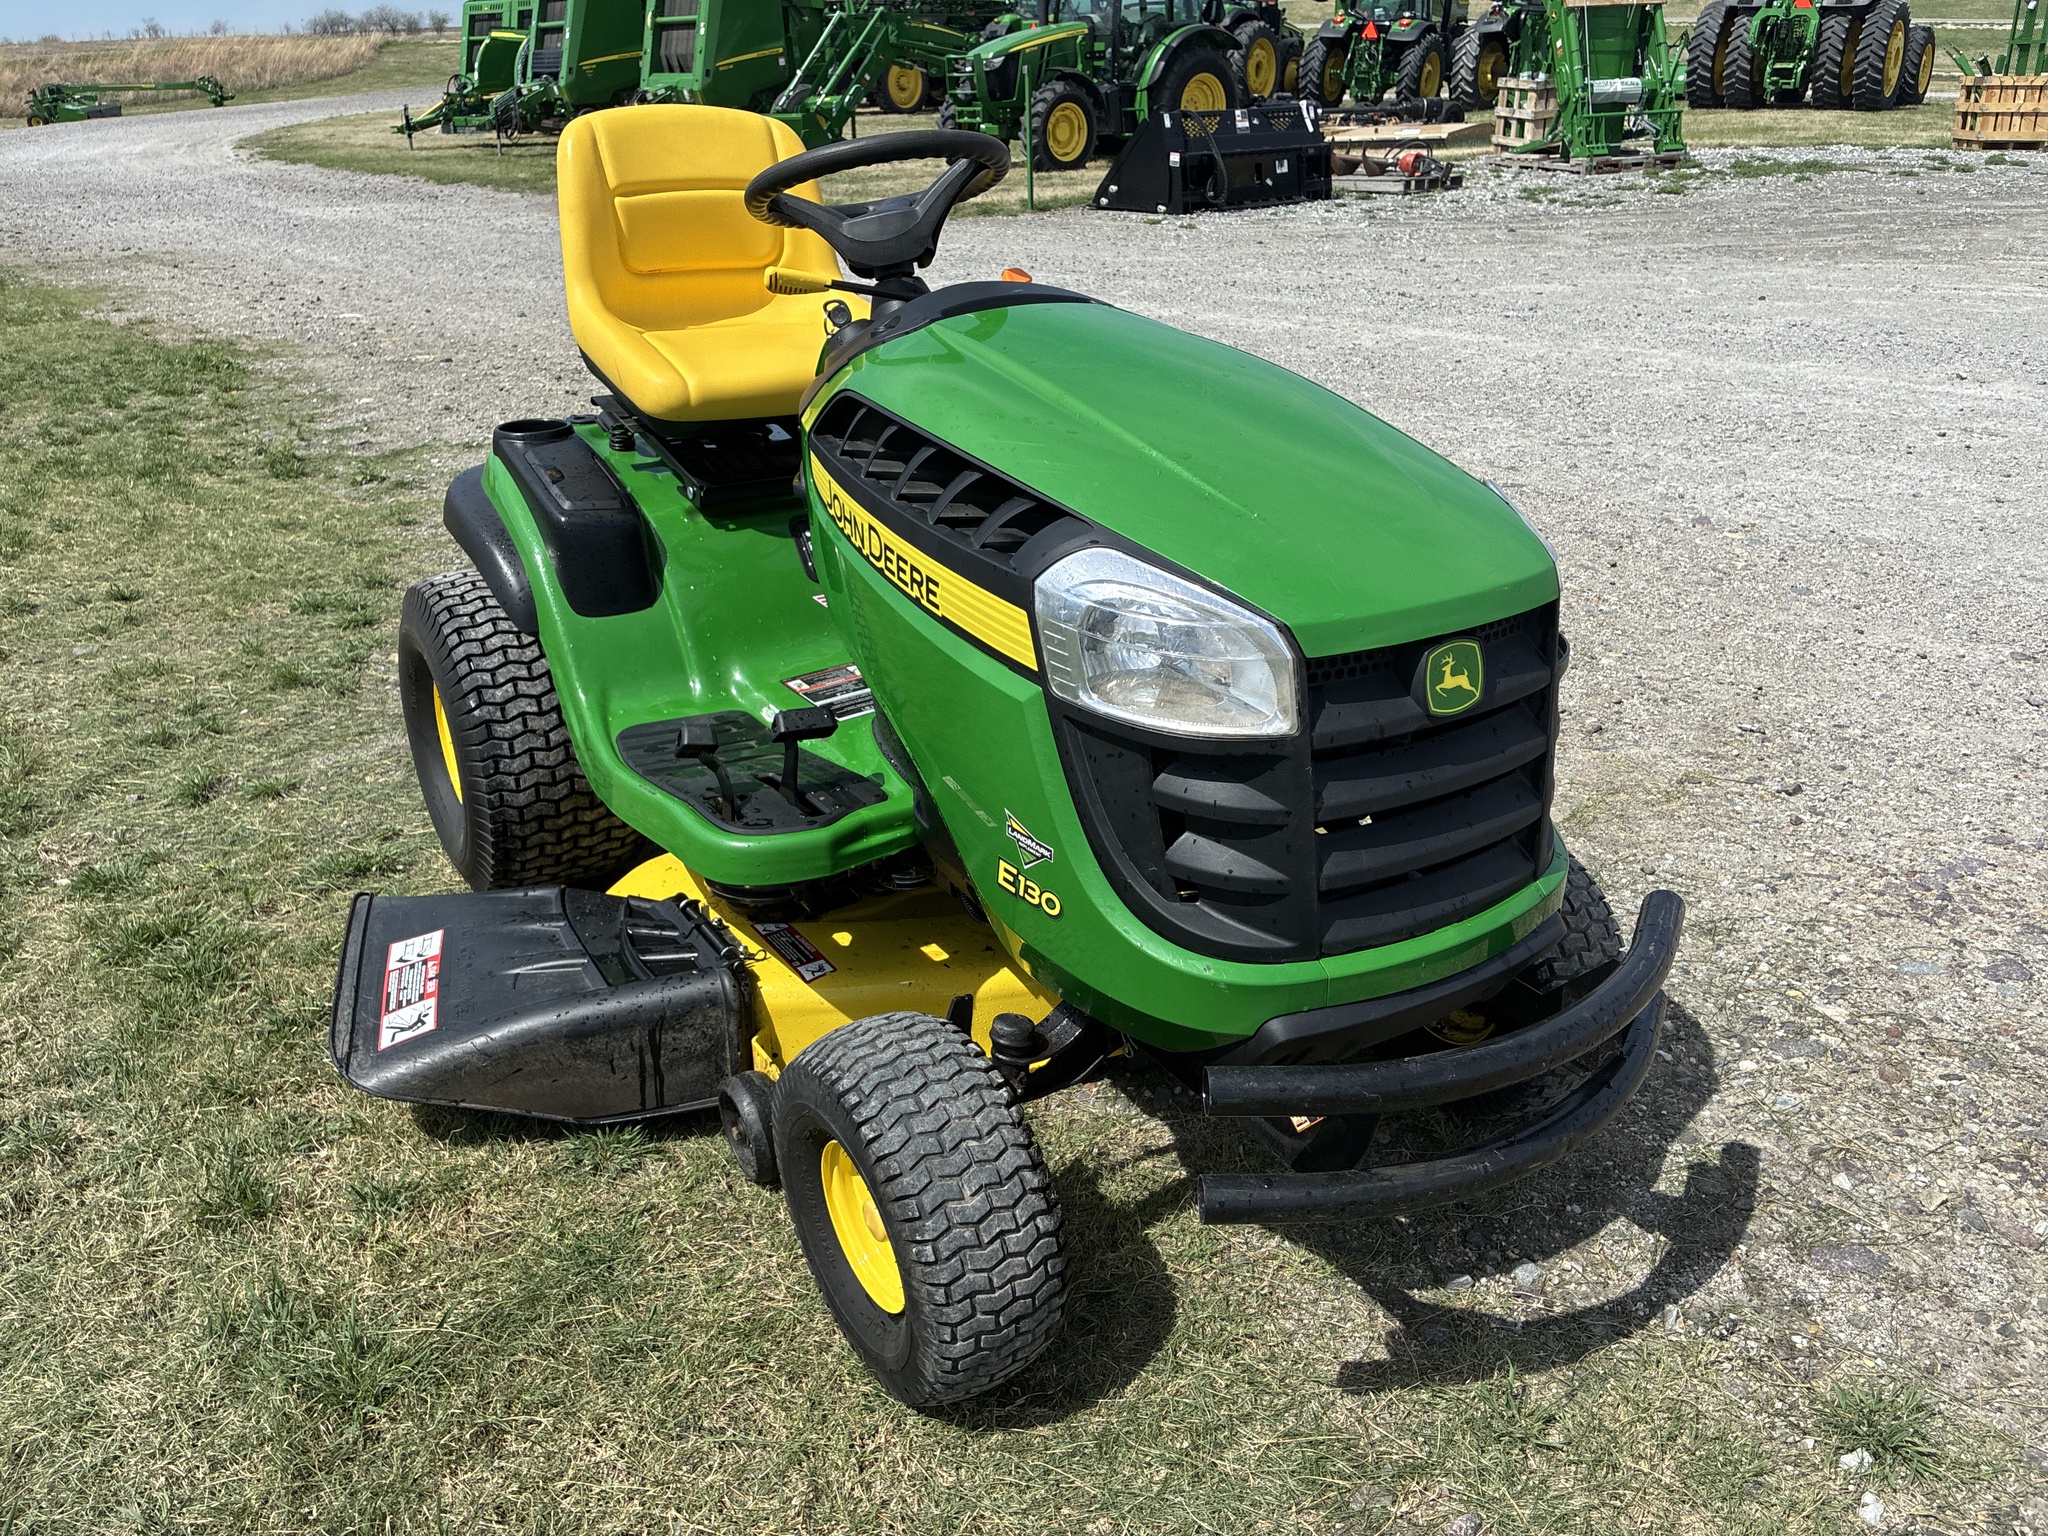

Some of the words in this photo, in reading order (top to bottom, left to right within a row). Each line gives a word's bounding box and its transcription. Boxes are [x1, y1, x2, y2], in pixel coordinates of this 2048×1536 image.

[825, 480, 865, 549] JOHN
[867, 522, 940, 610] DEERE
[1008, 827, 1051, 858] LANDMARK
[997, 859, 1062, 918] E130
